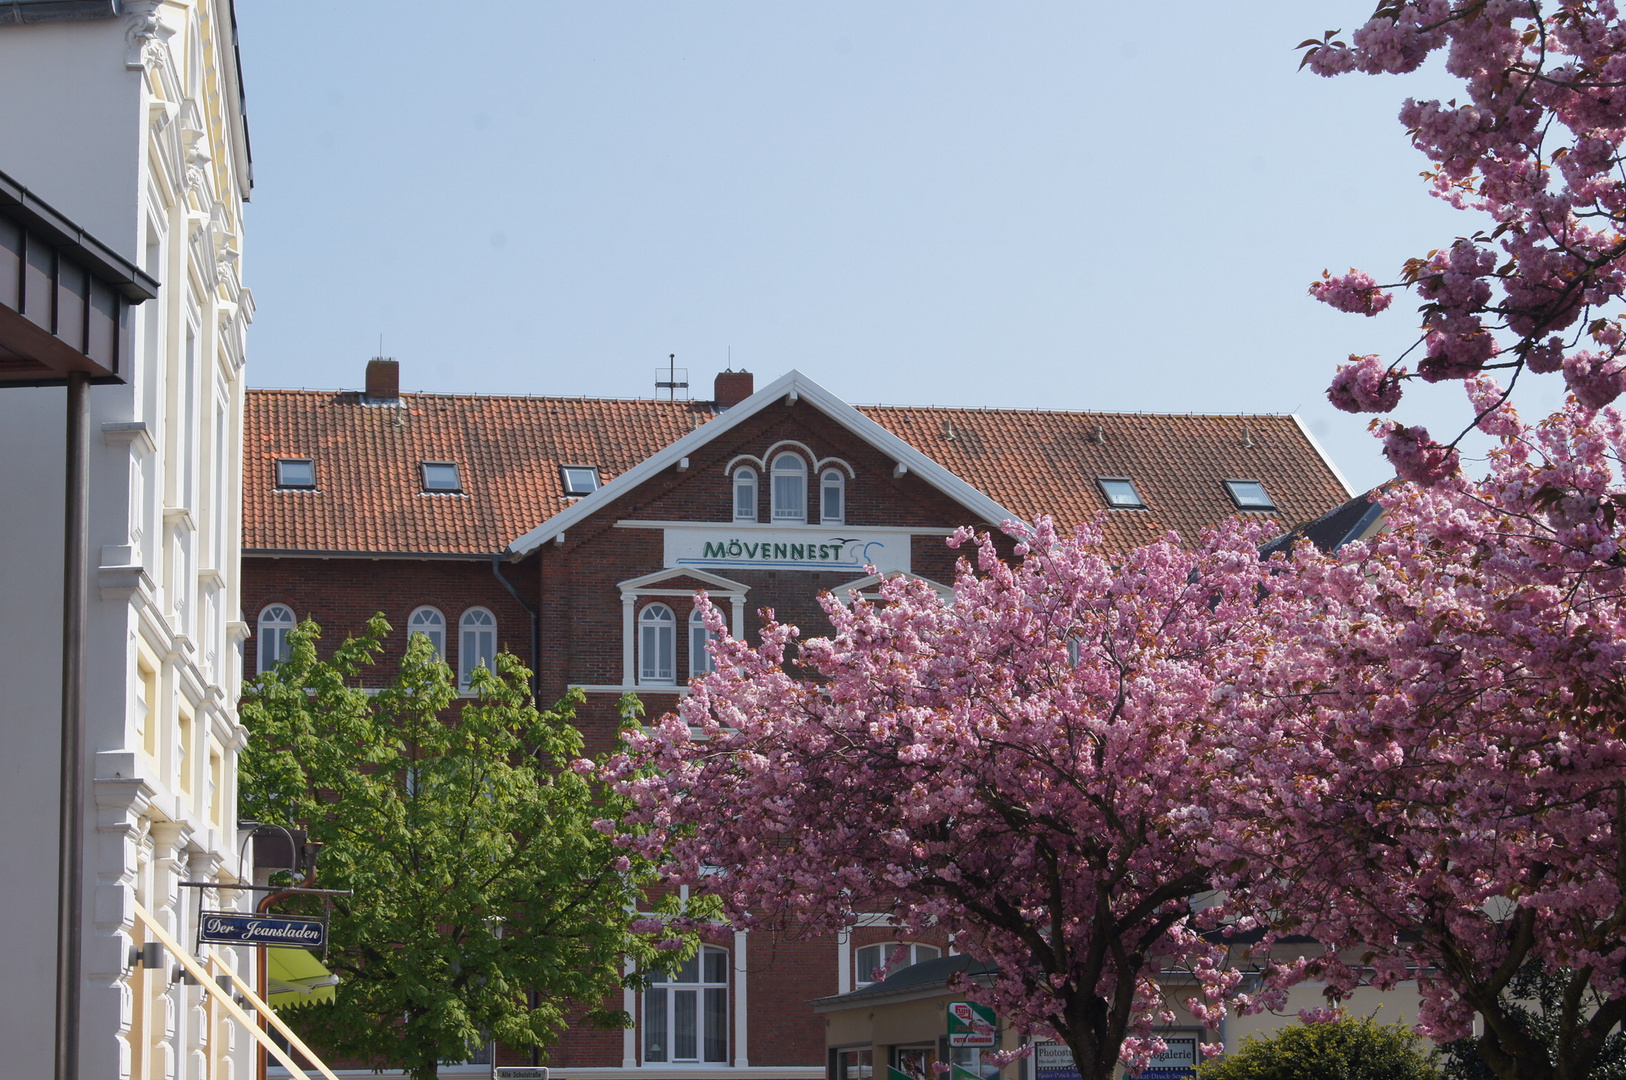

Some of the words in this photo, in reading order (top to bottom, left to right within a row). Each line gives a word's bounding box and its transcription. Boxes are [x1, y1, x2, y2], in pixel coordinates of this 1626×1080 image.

[703, 538, 843, 560] MÖVENNEST
[206, 918, 235, 933] Der
[241, 921, 320, 940] Jeansladen
